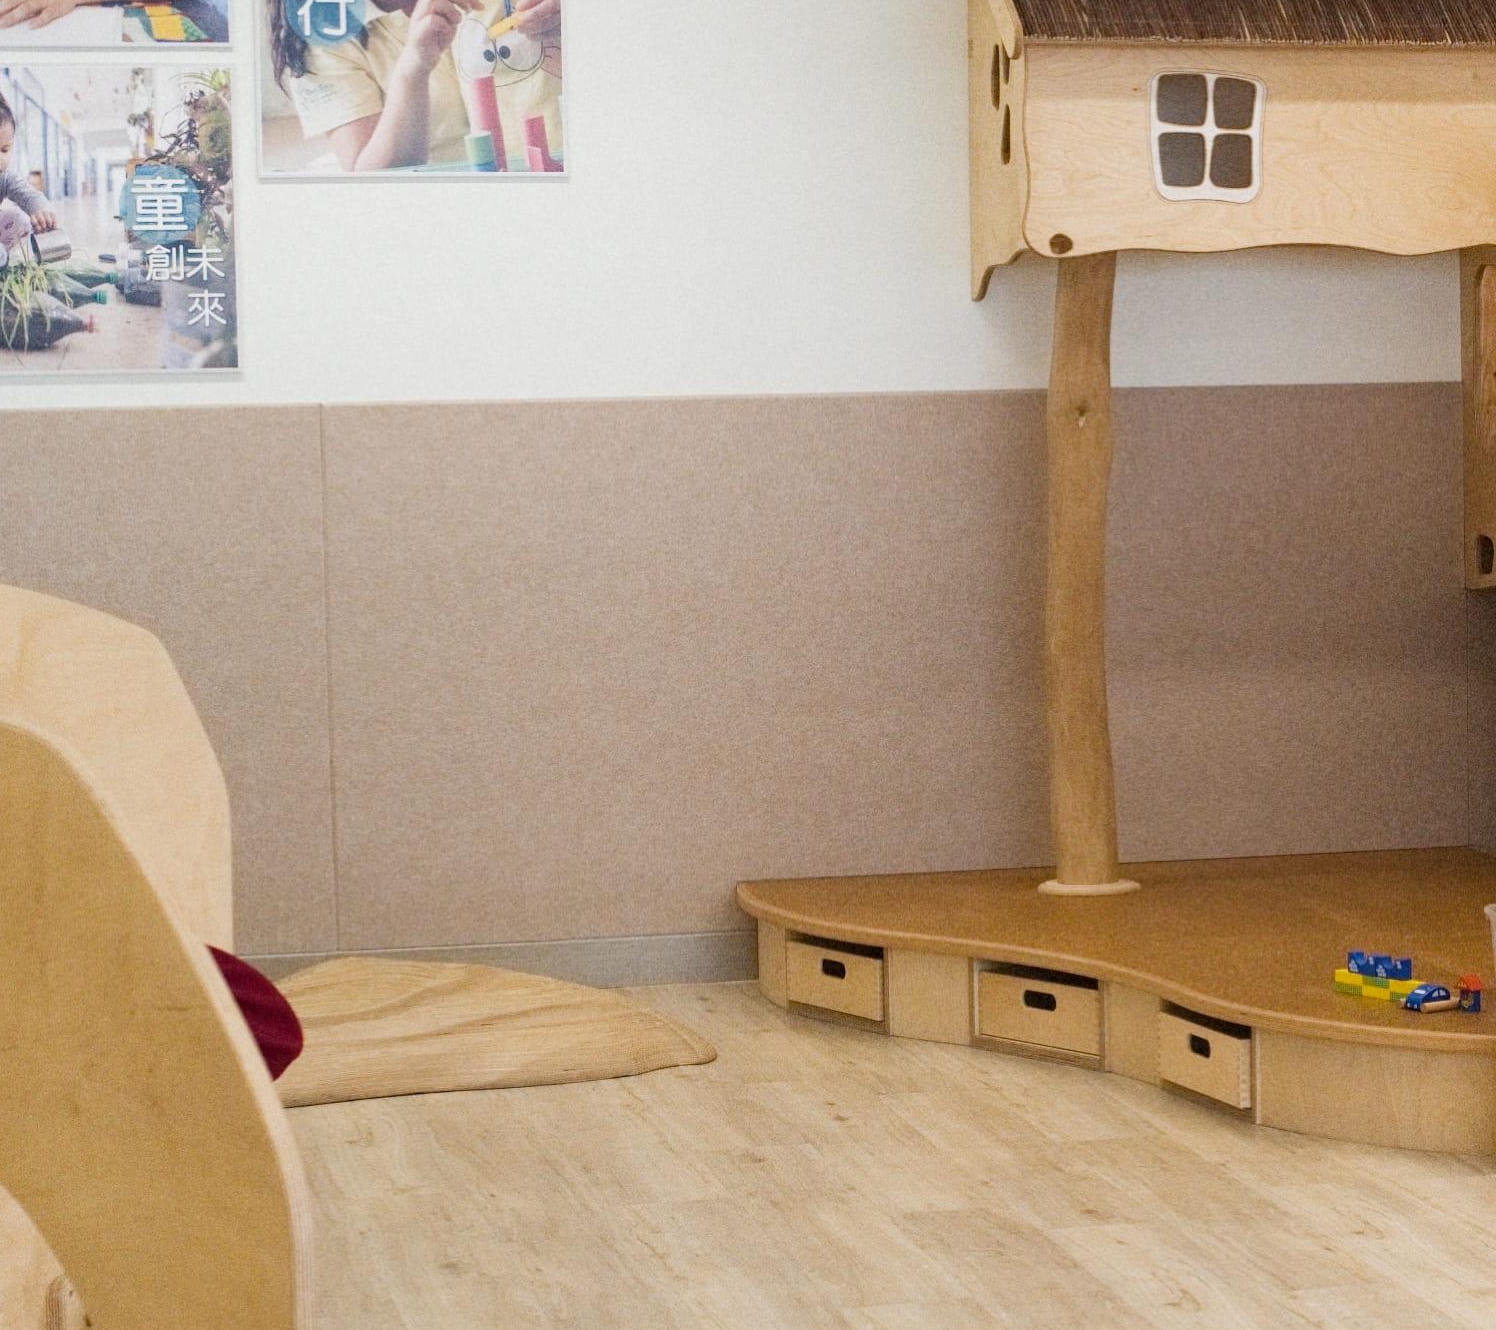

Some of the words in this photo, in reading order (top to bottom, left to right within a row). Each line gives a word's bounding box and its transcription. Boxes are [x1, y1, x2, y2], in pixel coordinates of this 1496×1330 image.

[131, 175, 189, 231] 童
[145, 244, 226, 281] 創未
[188, 289, 227, 327] 來
